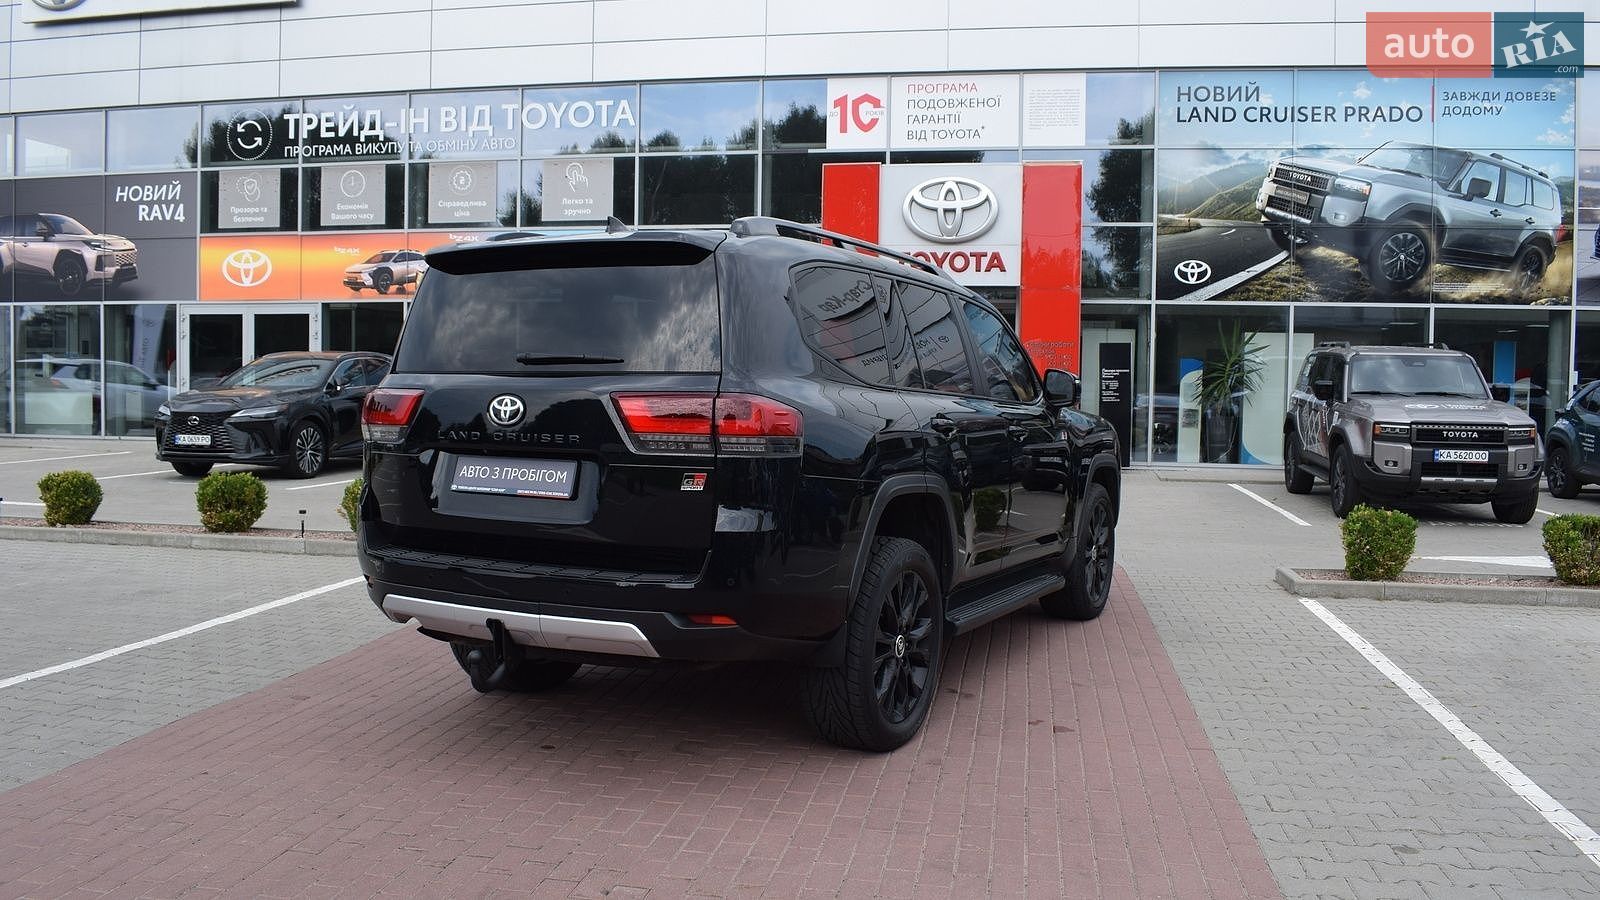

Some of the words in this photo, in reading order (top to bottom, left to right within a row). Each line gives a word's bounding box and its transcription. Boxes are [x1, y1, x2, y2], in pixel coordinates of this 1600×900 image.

[907, 83, 978, 94] ПРОГРАМА
[1176, 81, 1261, 102] НОВИЙ
[907, 94, 1002, 111] ПОДОВЖЕНОЇ
[1442, 91, 1501, 103] ЗАВЖДИ
[1504, 91, 1557, 103] ДОВЕЗЕ
[907, 111, 962, 124] ГАРАНТІЇ
[1176, 106, 1237, 123] LAND
[1243, 105, 1337, 123] CRUISER
[1344, 105, 1423, 123] PRADO
[1442, 105, 1504, 117] ДОДОМУ
[283, 104, 430, 142] ТРЕЙД-ІН
[440, 104, 494, 137] ВІД
[502, 99, 636, 130] TOYOTA
[907, 129, 928, 142] ВІД
[284, 143, 352, 158] ПРОГРАМА
[355, 142, 404, 155] ВИКУПУ
[408, 140, 423, 153] ТА
[426, 138, 478, 152] ОБМІНУ
[482, 137, 516, 150] АВТО
[1289, 171, 1312, 182] TOYOTA
[115, 180, 181, 202] НОВИЙ
[138, 203, 186, 222] RAV4
[230, 206, 259, 214] Прозора
[336, 203, 369, 211] Економія
[330, 212, 358, 220] Вашого
[899, 251, 1007, 273] OYOTA
[438, 430, 481, 440] LAND
[493, 431, 581, 444] CRUISER
[1440, 450, 1452, 460] KA
[1453, 451, 1474, 460] 5620
[459, 465, 490, 479] АВТО
[501, 467, 568, 483] ПРОБІГОМ
